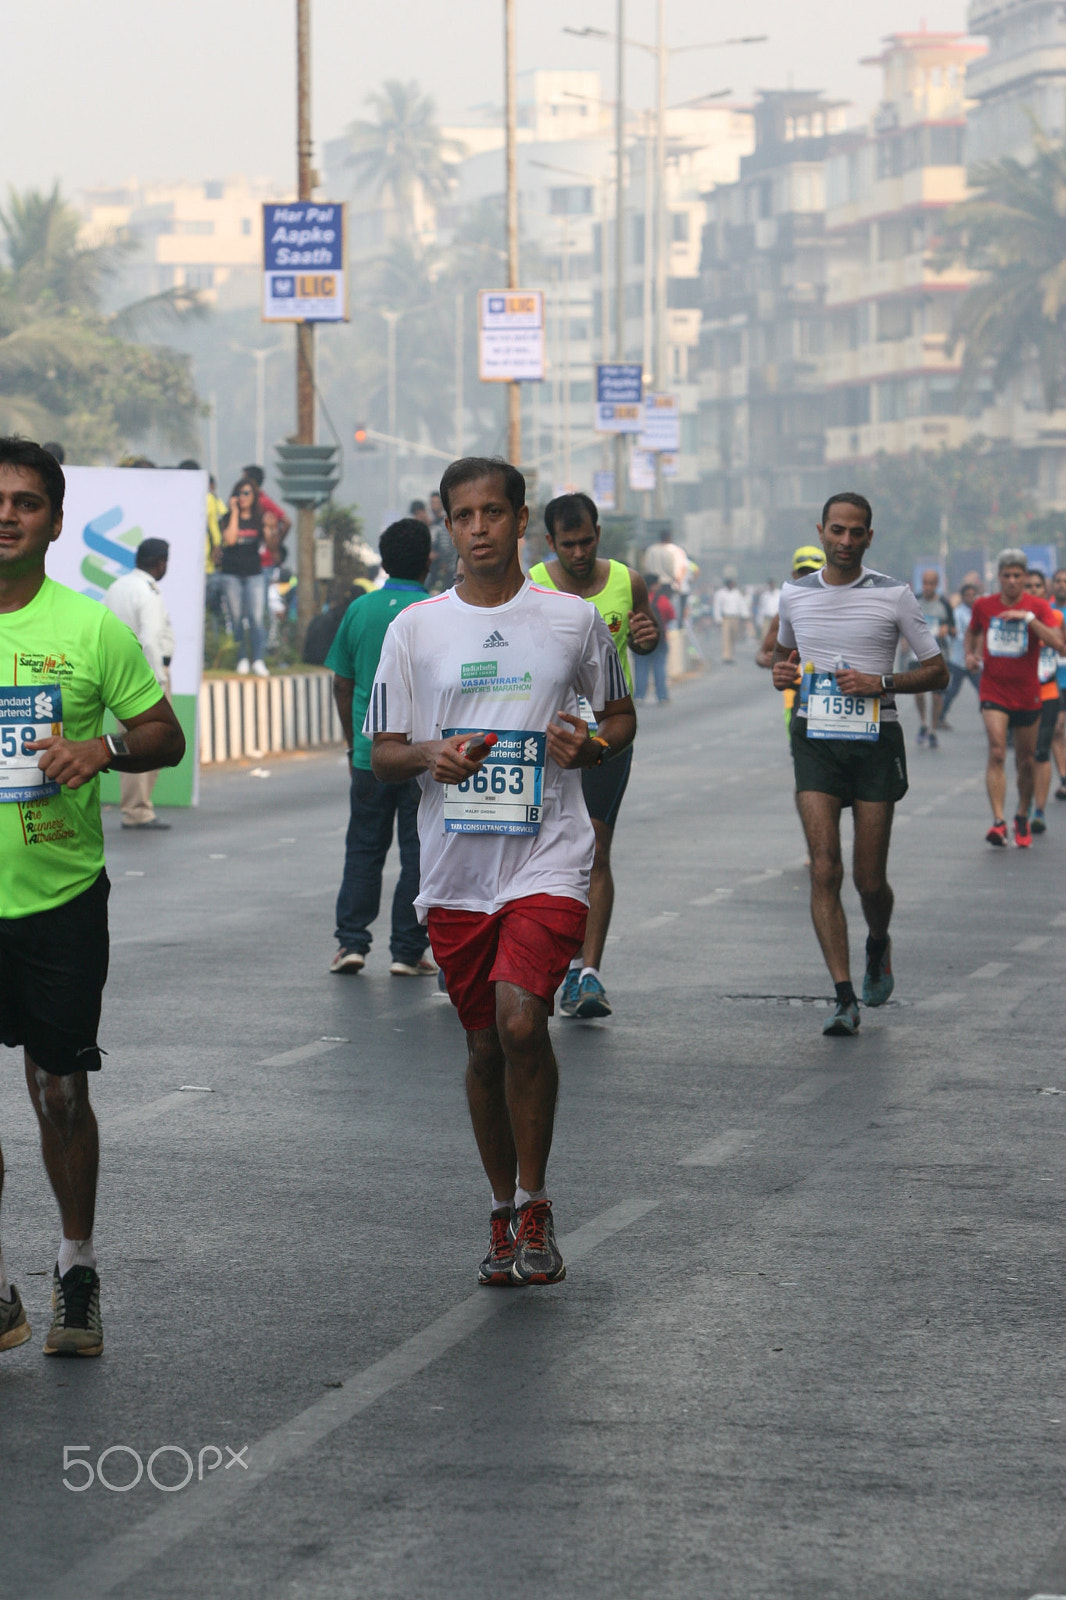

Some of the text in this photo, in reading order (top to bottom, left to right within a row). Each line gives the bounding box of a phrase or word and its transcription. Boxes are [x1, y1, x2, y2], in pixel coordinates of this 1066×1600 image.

[273, 207, 335, 223] Har Pal
[271, 226, 336, 248] Aapke
[275, 247, 333, 266] Saath
[300, 276, 333, 296] LIC
[482, 640, 509, 649] adidas
[19, 656, 44, 667] Satara
[462, 663, 497, 673] Indiabulls
[461, 676, 518, 687] VASAI-VIRAR
[461, 683, 532, 695] MAYOR'S MARATHON
[0, 696, 31, 707] andard
[823, 696, 865, 716] 1596
[0, 707, 31, 718] artered
[869, 723, 877, 733] A
[1, 726, 37, 758] 58
[488, 750, 522, 759] artered
[0, 791, 23, 800] TANCY
[25, 810, 41, 821] Are
[529, 807, 539, 822] B
[463, 823, 507, 832] CONSULTANCY
[508, 825, 534, 833] SERVICES
